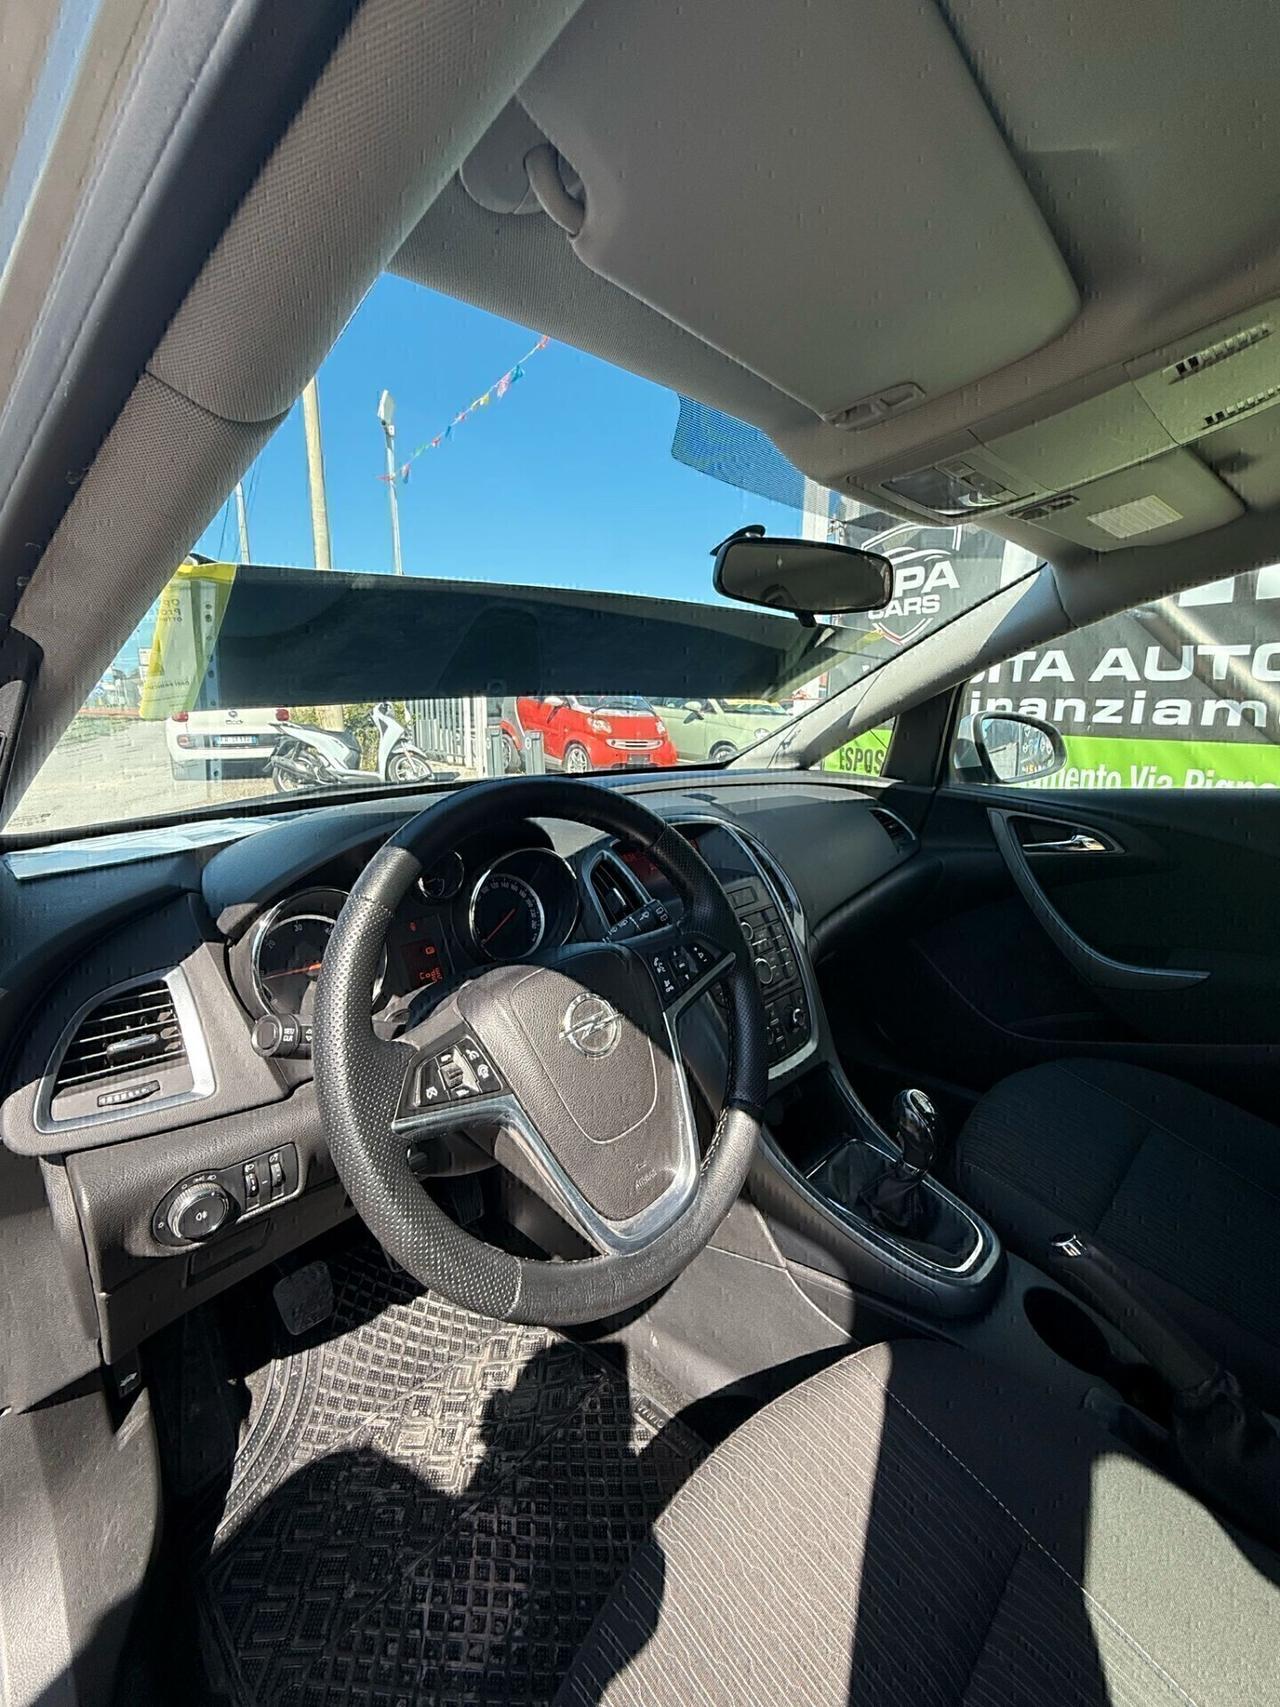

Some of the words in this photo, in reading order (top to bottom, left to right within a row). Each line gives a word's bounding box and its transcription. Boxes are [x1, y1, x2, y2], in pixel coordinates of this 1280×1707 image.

[894, 560, 960, 598] PA
[969, 650, 1076, 684] ITA
[970, 690, 1280, 728] inanziam
